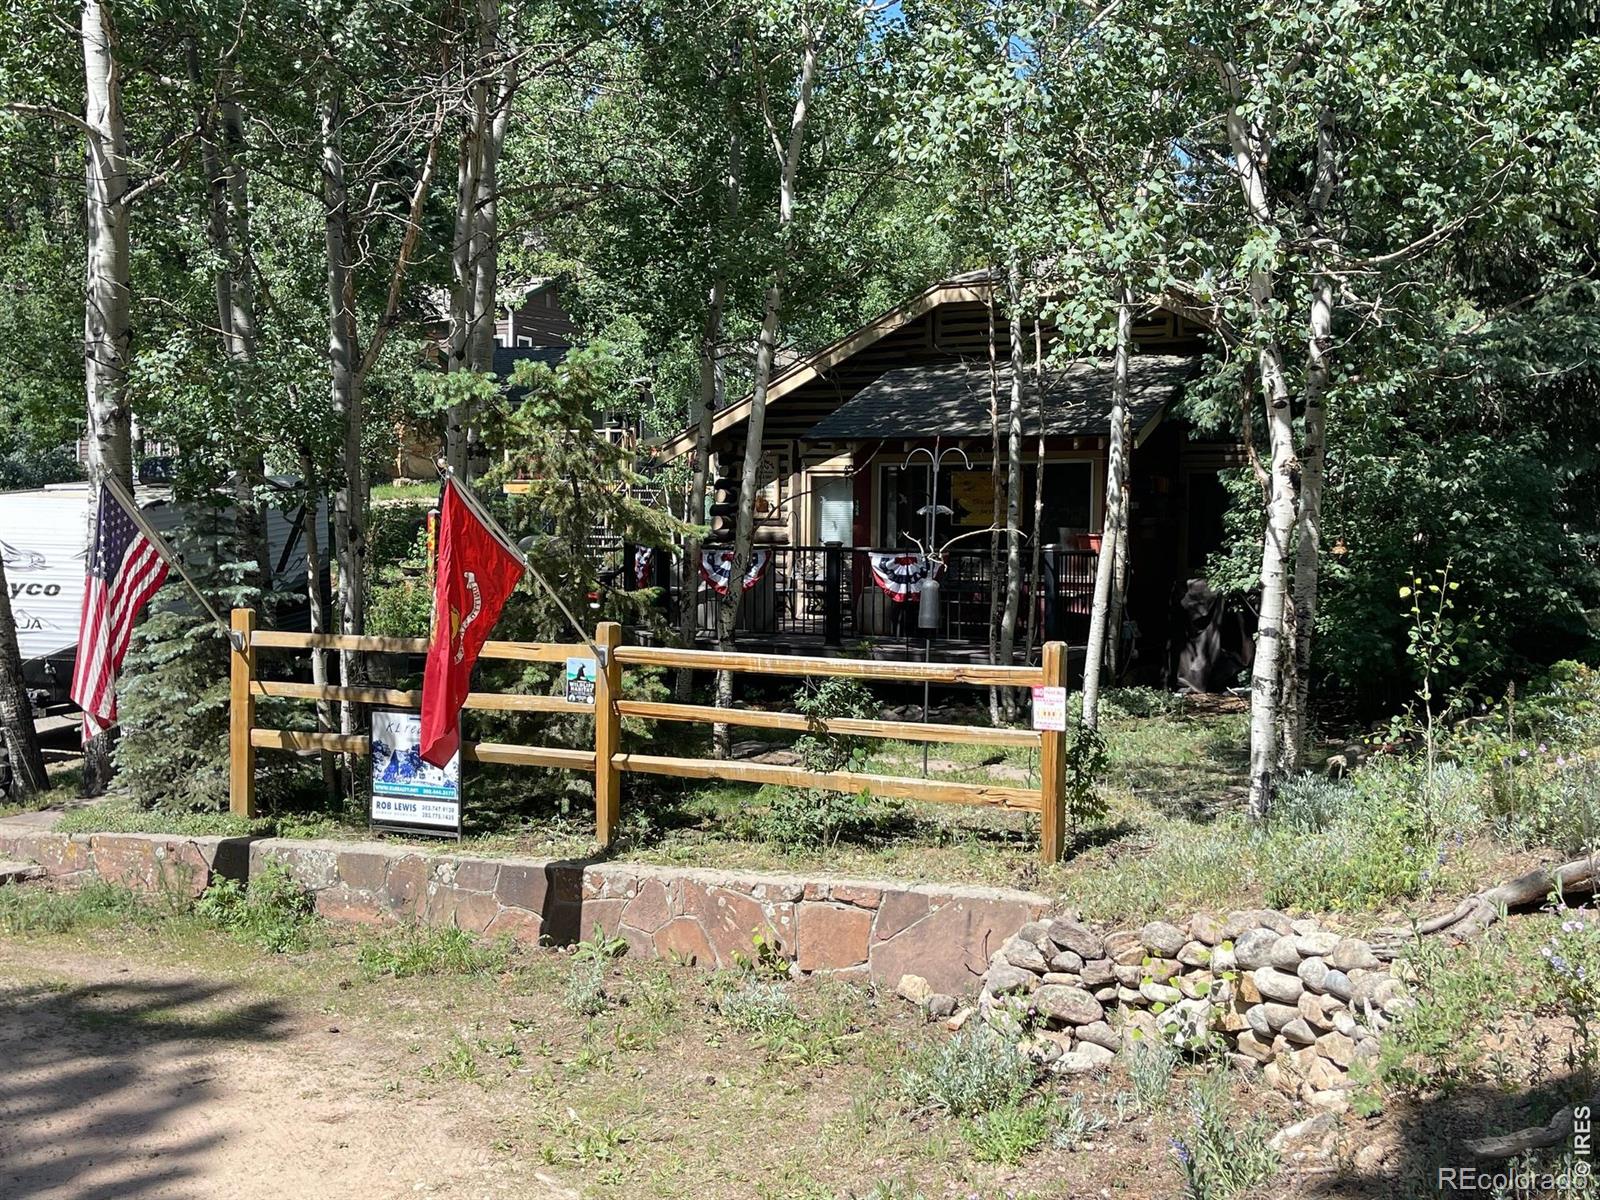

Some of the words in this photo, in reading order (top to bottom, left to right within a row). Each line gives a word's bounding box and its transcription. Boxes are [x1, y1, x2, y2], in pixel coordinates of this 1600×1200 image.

[10, 583, 61, 599] yco
[386, 721, 401, 733] KL
[376, 801, 392, 810] ROB
[394, 803, 417, 812] LEWIS
